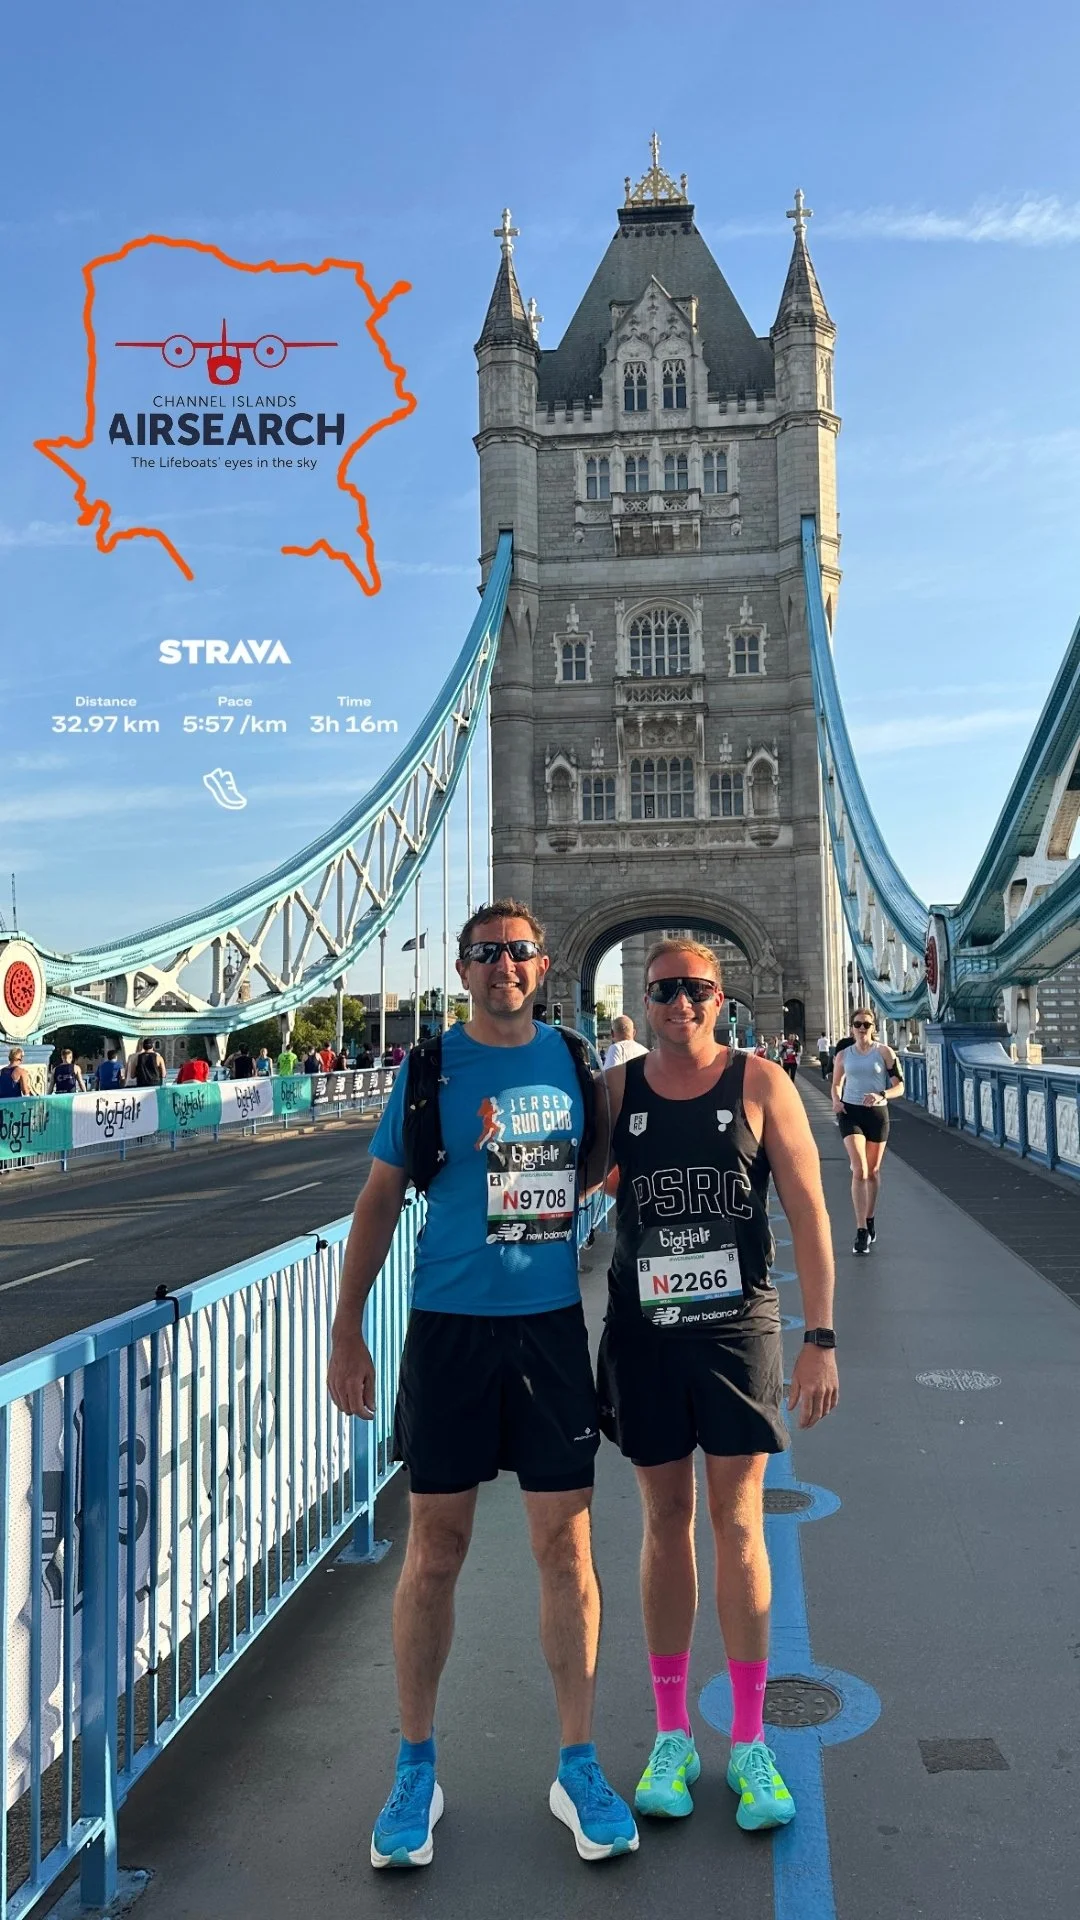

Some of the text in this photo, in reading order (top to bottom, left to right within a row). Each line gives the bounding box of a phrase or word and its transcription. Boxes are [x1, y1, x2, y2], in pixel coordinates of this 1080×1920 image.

[510, 1095, 572, 1112] JERSEY
[511, 1110, 572, 1136] RUN CLUB
[503, 1188, 566, 1210] N9708
[631, 1166, 753, 1225] PSRC
[642, 1262, 648, 1271] 3
[652, 1269, 728, 1296] N2266
[682, 1309, 739, 1323] new balance
